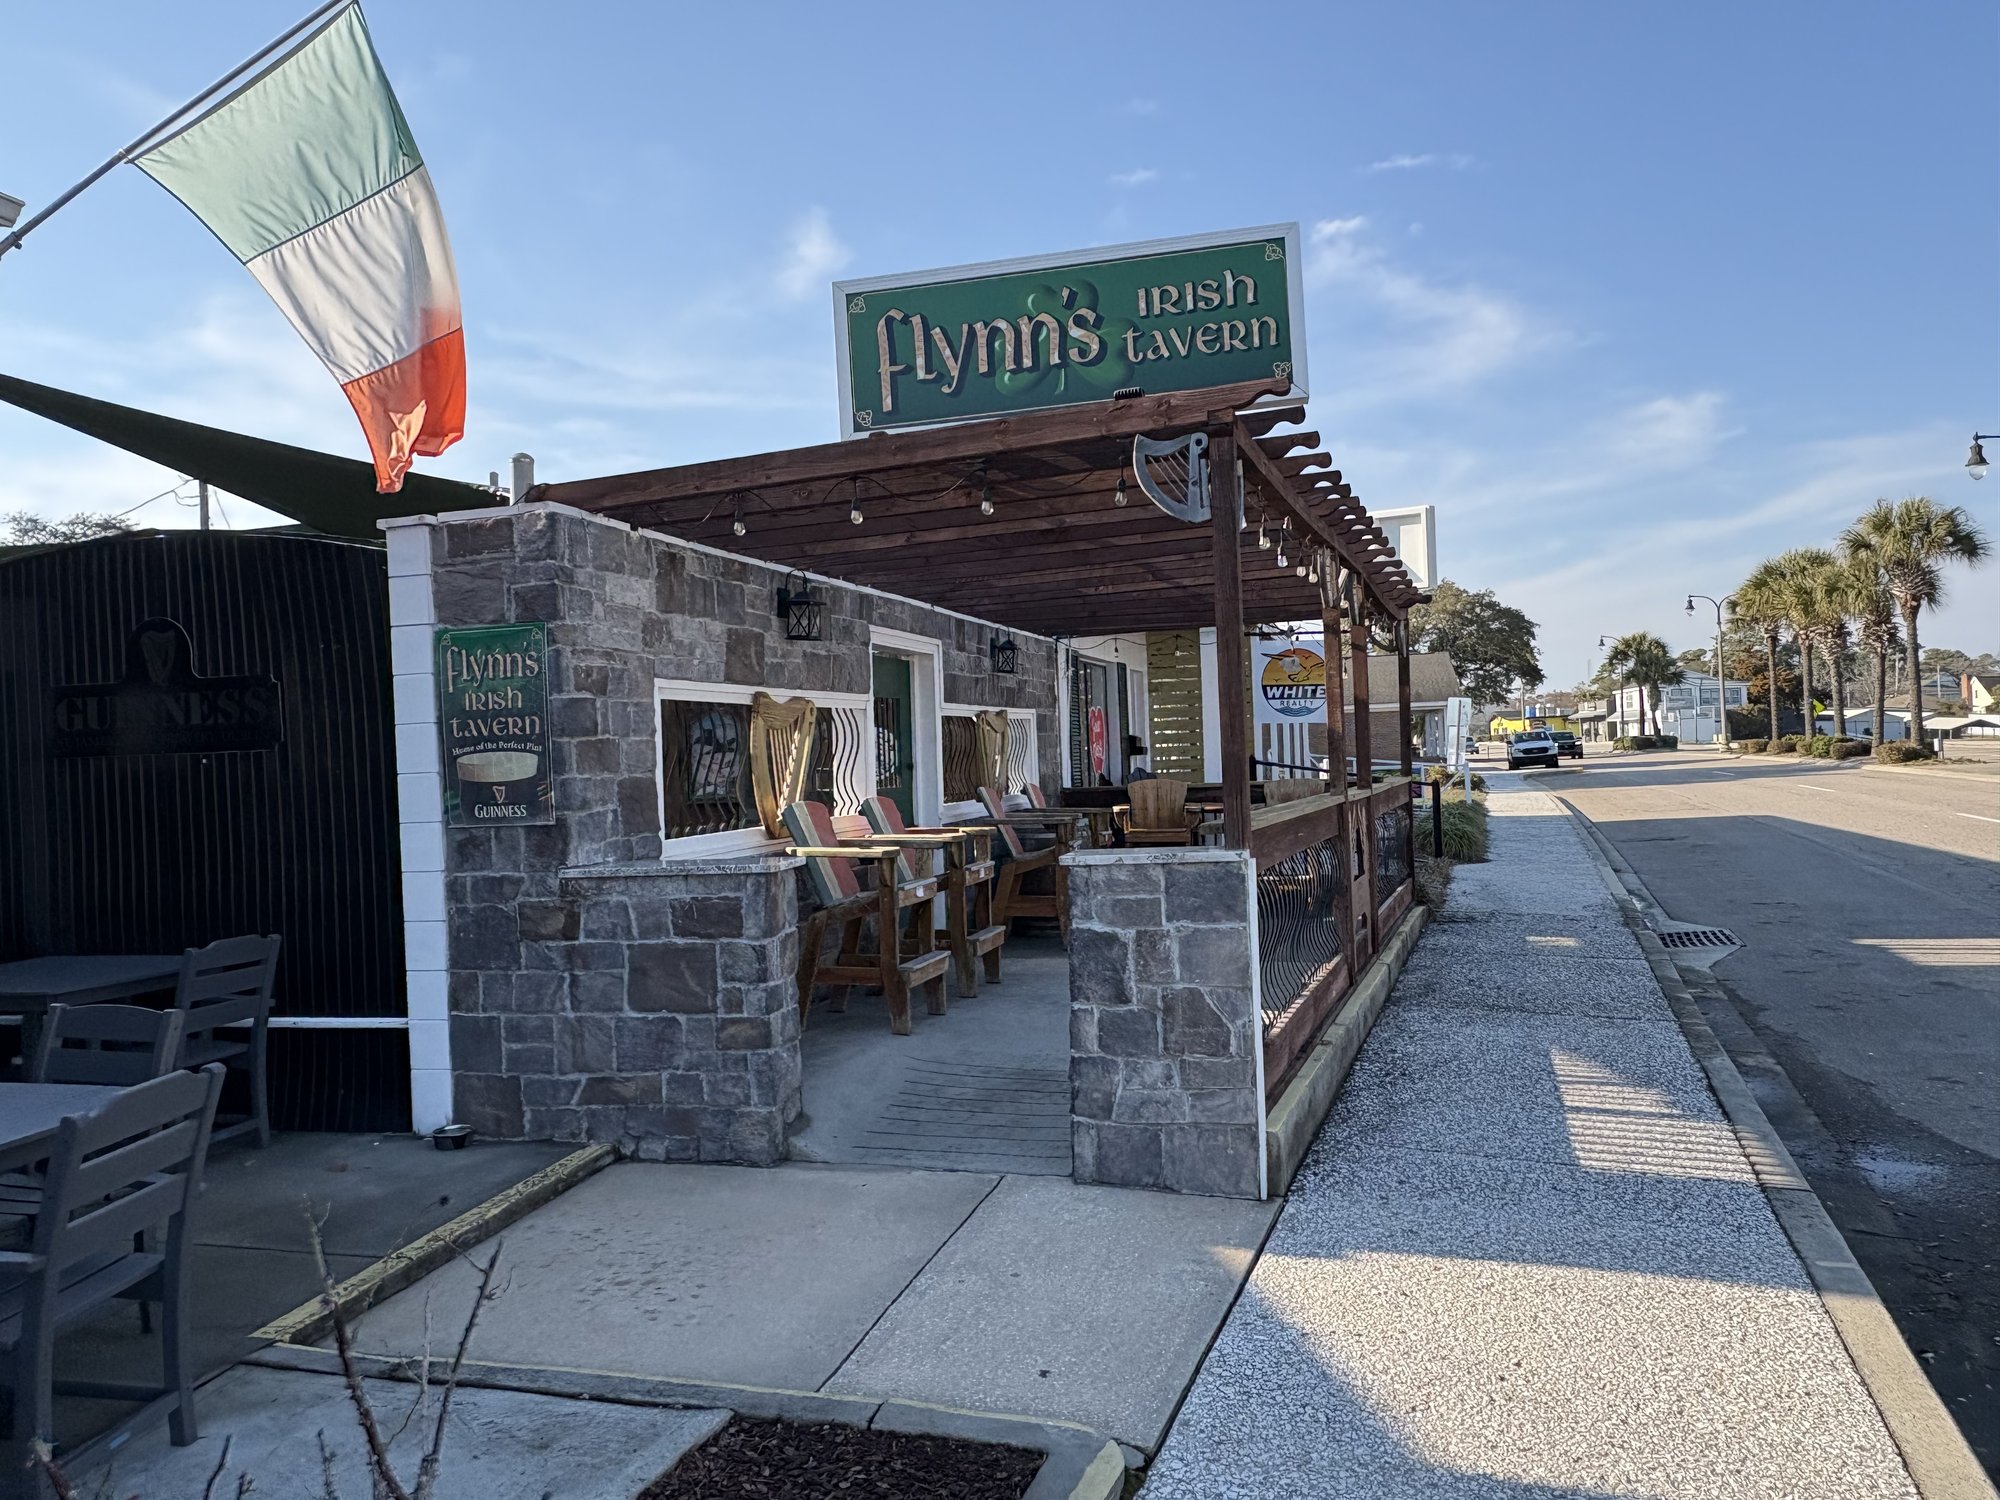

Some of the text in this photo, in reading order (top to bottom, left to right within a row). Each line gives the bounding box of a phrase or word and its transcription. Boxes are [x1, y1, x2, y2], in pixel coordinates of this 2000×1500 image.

[1266, 686, 1326, 699] WHITE
[499, 741, 525, 750] Perfect
[526, 742, 543, 752] Pint
[474, 804, 528, 819] GUINNESS
